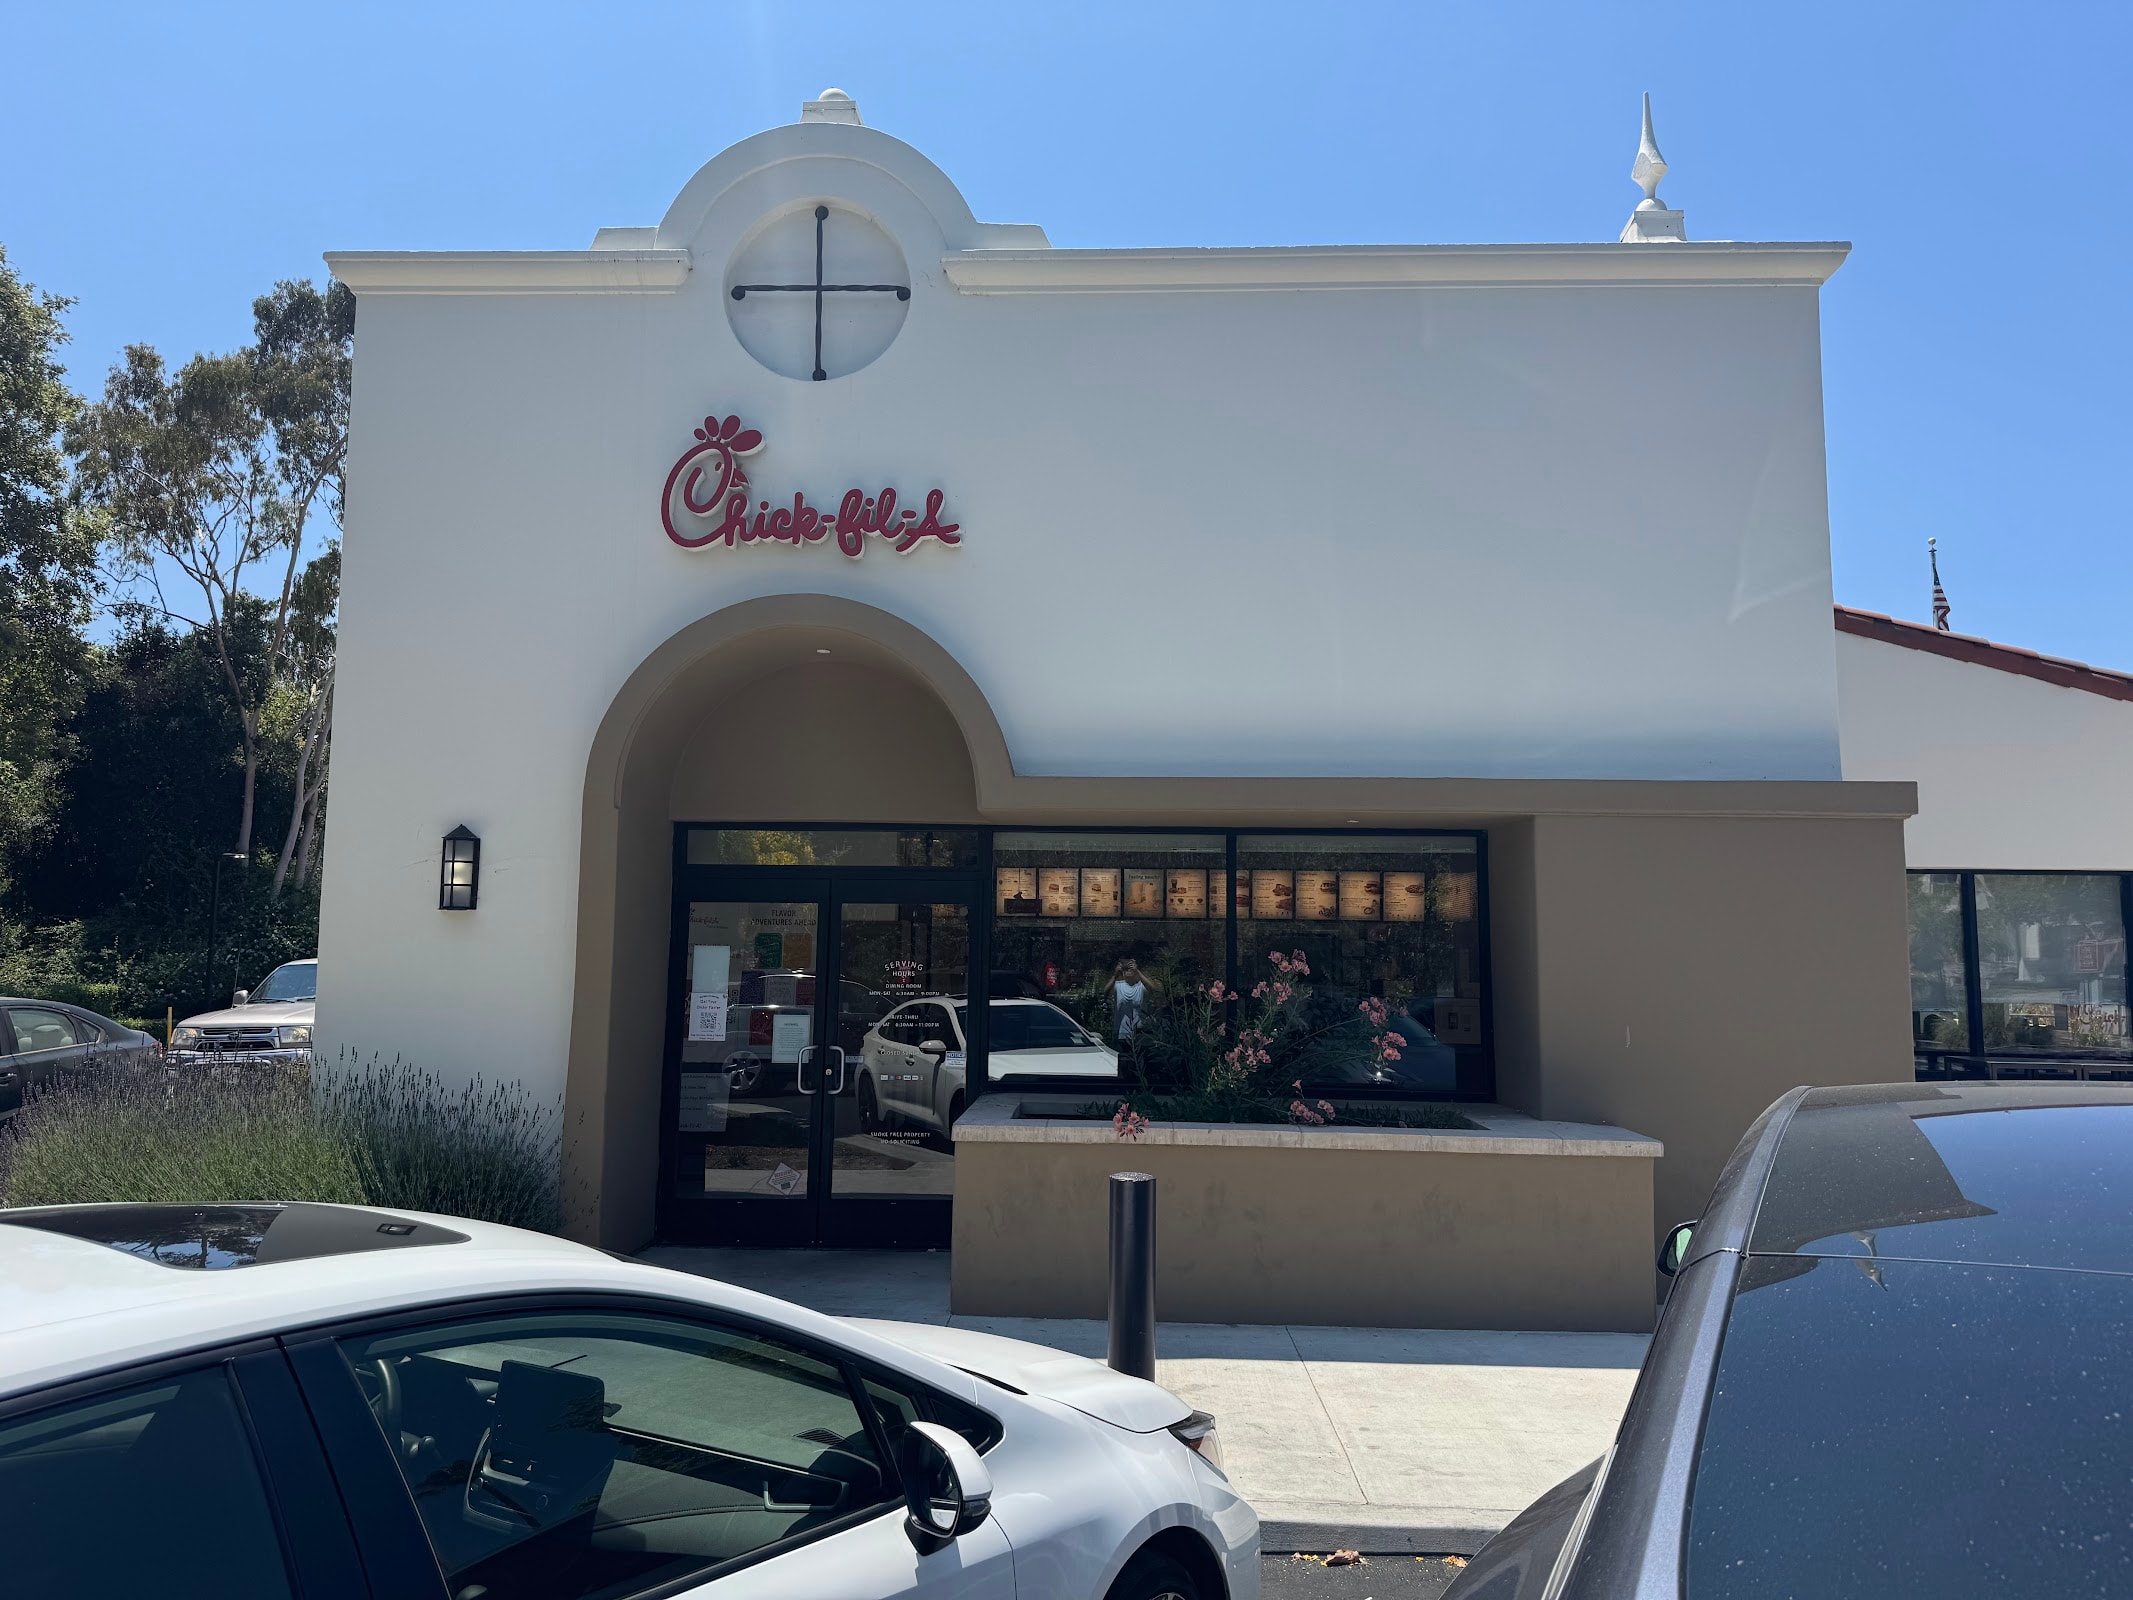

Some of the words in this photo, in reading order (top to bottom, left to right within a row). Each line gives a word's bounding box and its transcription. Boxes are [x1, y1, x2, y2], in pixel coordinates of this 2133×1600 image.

[661, 415, 962, 557] Chick-fil-A
[771, 909, 797, 917] FLAVOR
[750, 918, 793, 926] ADVENTURES
[794, 918, 817, 926] AHEAD
[884, 960, 924, 971] SERVING
